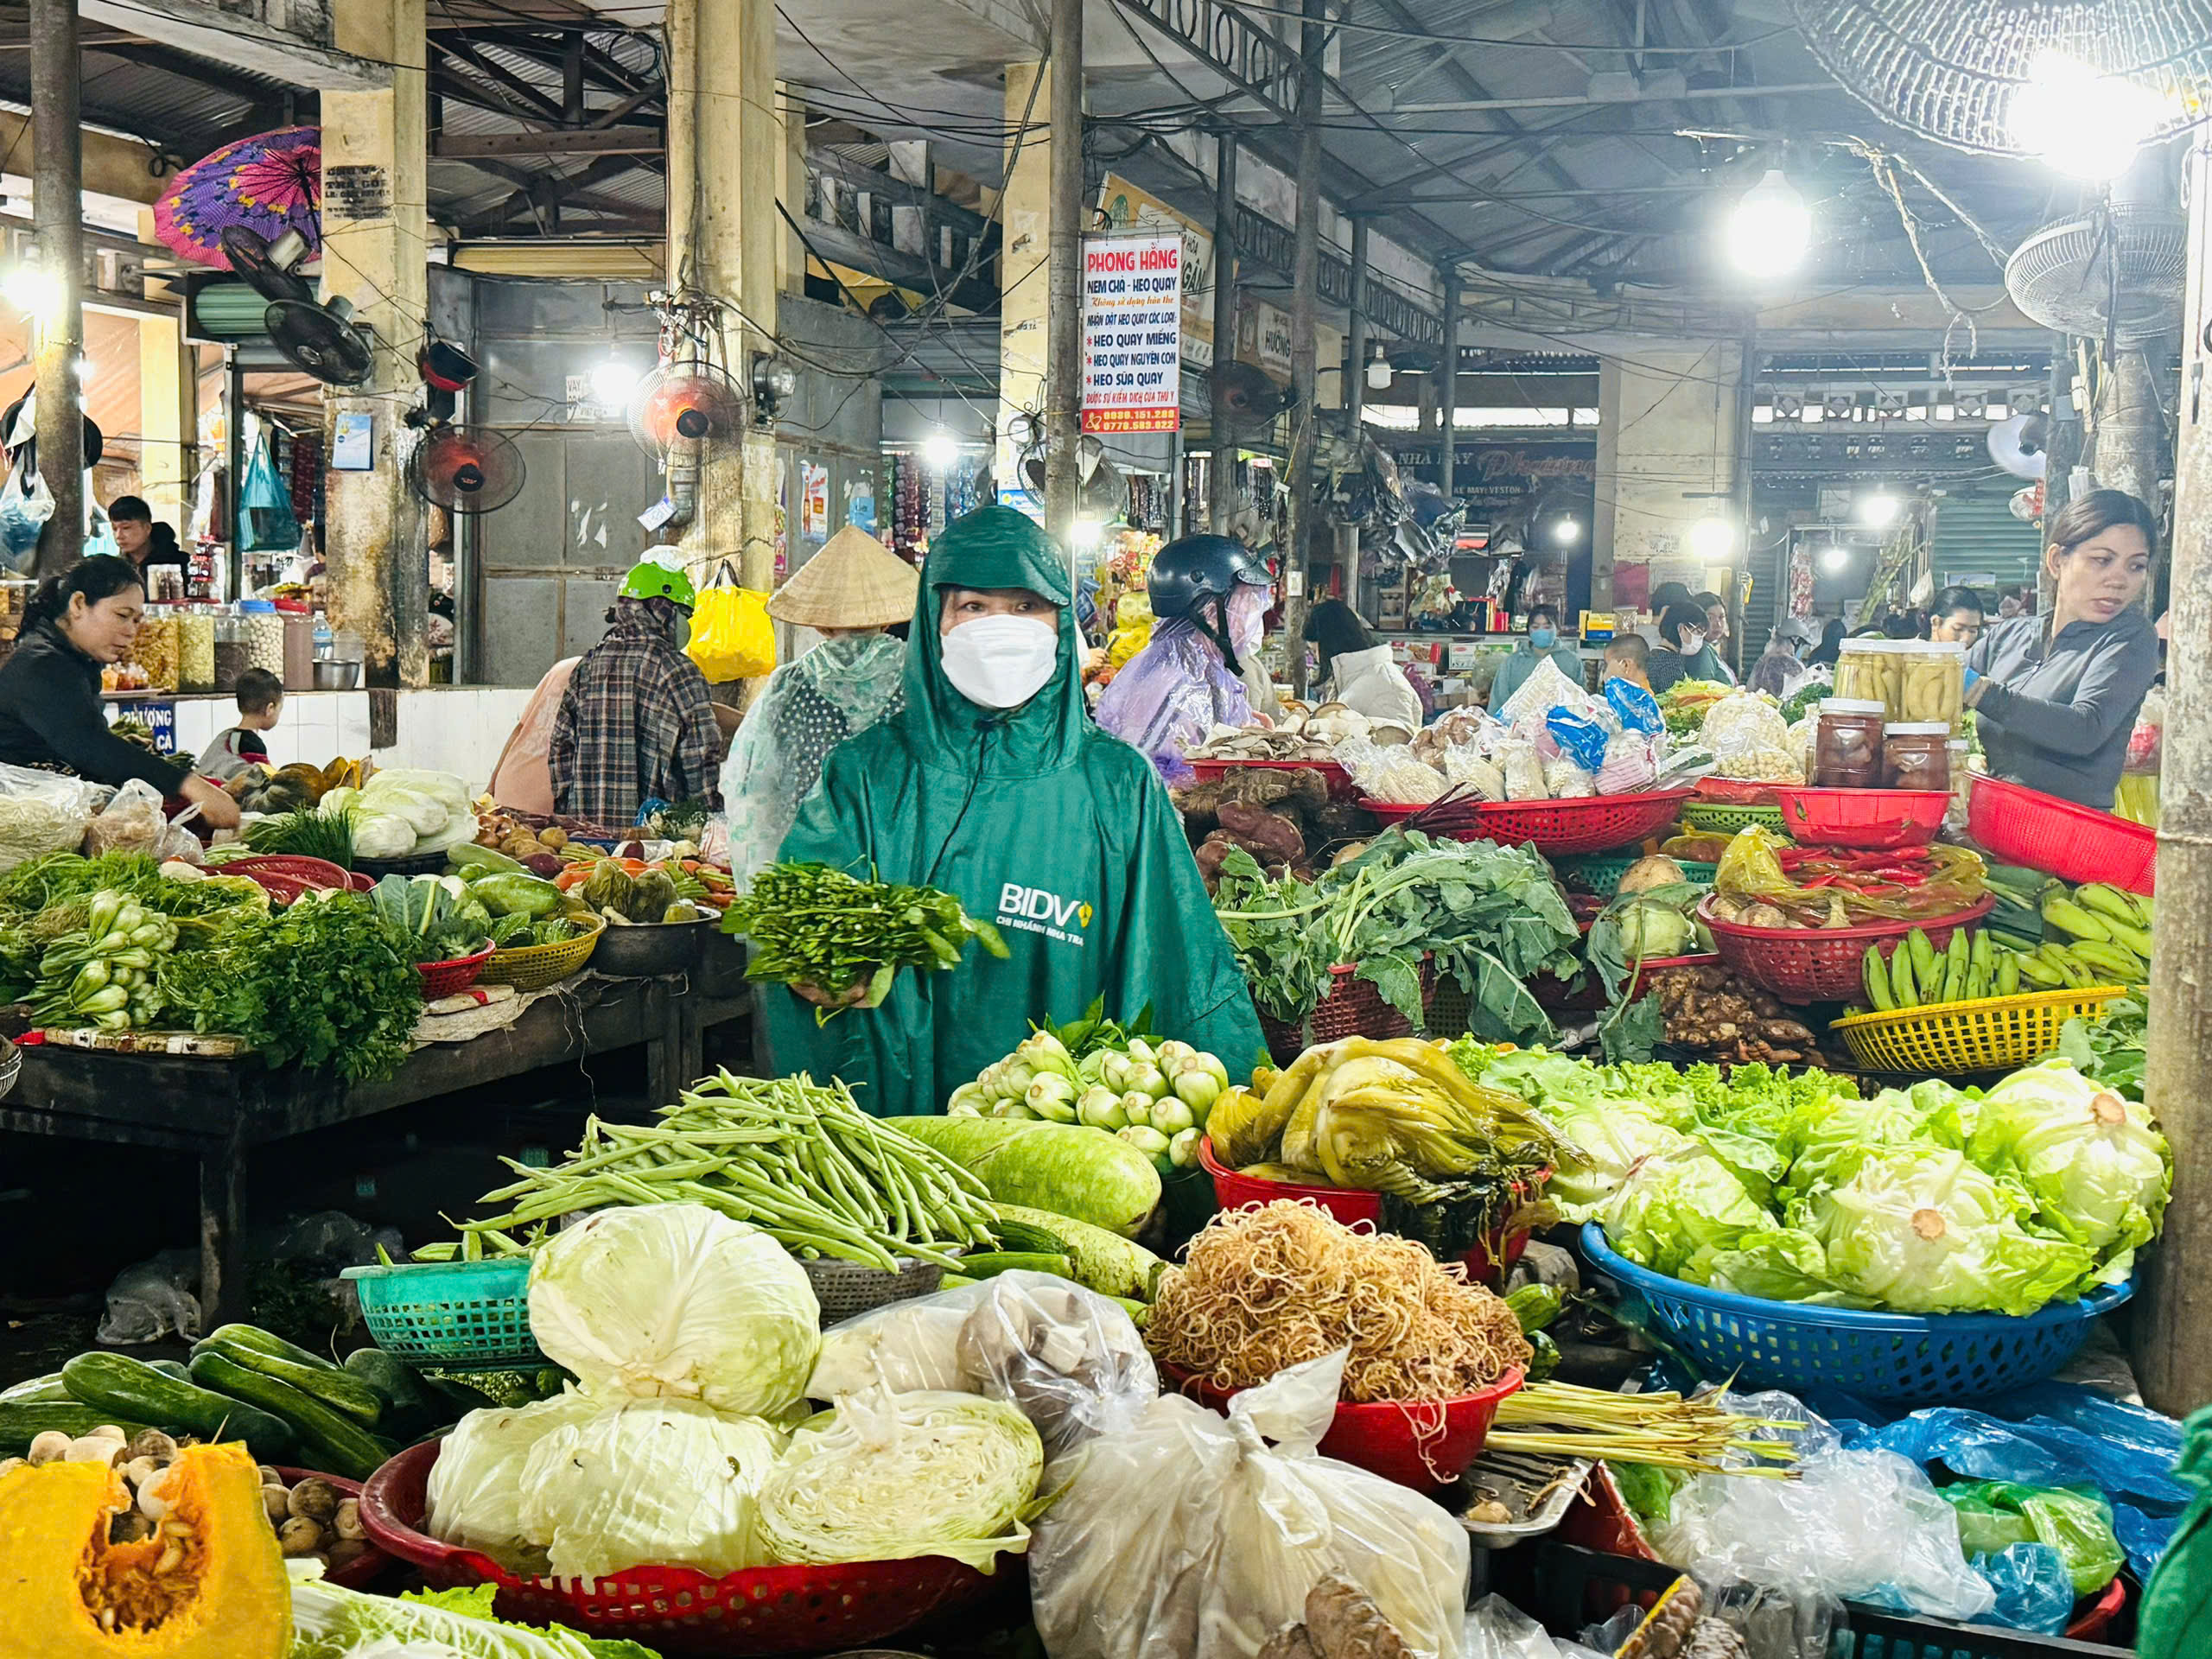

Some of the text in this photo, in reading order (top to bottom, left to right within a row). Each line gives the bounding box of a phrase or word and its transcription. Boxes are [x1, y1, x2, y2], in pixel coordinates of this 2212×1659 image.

[1087, 251, 1135, 272] PHONG
[1087, 280, 1107, 294] NEM
[1133, 277, 1150, 292] HEO
[1152, 276, 1177, 293] QUAY
[1118, 313, 1130, 325] HEO
[1131, 313, 1147, 327] QUAY
[1094, 334, 1114, 346] HEO
[1116, 333, 1143, 347] QUAY
[1146, 327, 1176, 345] MIẾNG
[1093, 350, 1176, 368] HEO QUAY NGUYÊN CON
[1093, 371, 1163, 386] HEO SỮA QUAY
[1170, 391, 1174, 402] Y
[1436, 452, 1474, 465] AY
[998, 882, 1081, 927] BIDV
[995, 915, 1012, 926] CHI
[1046, 927, 1065, 940] NHA
